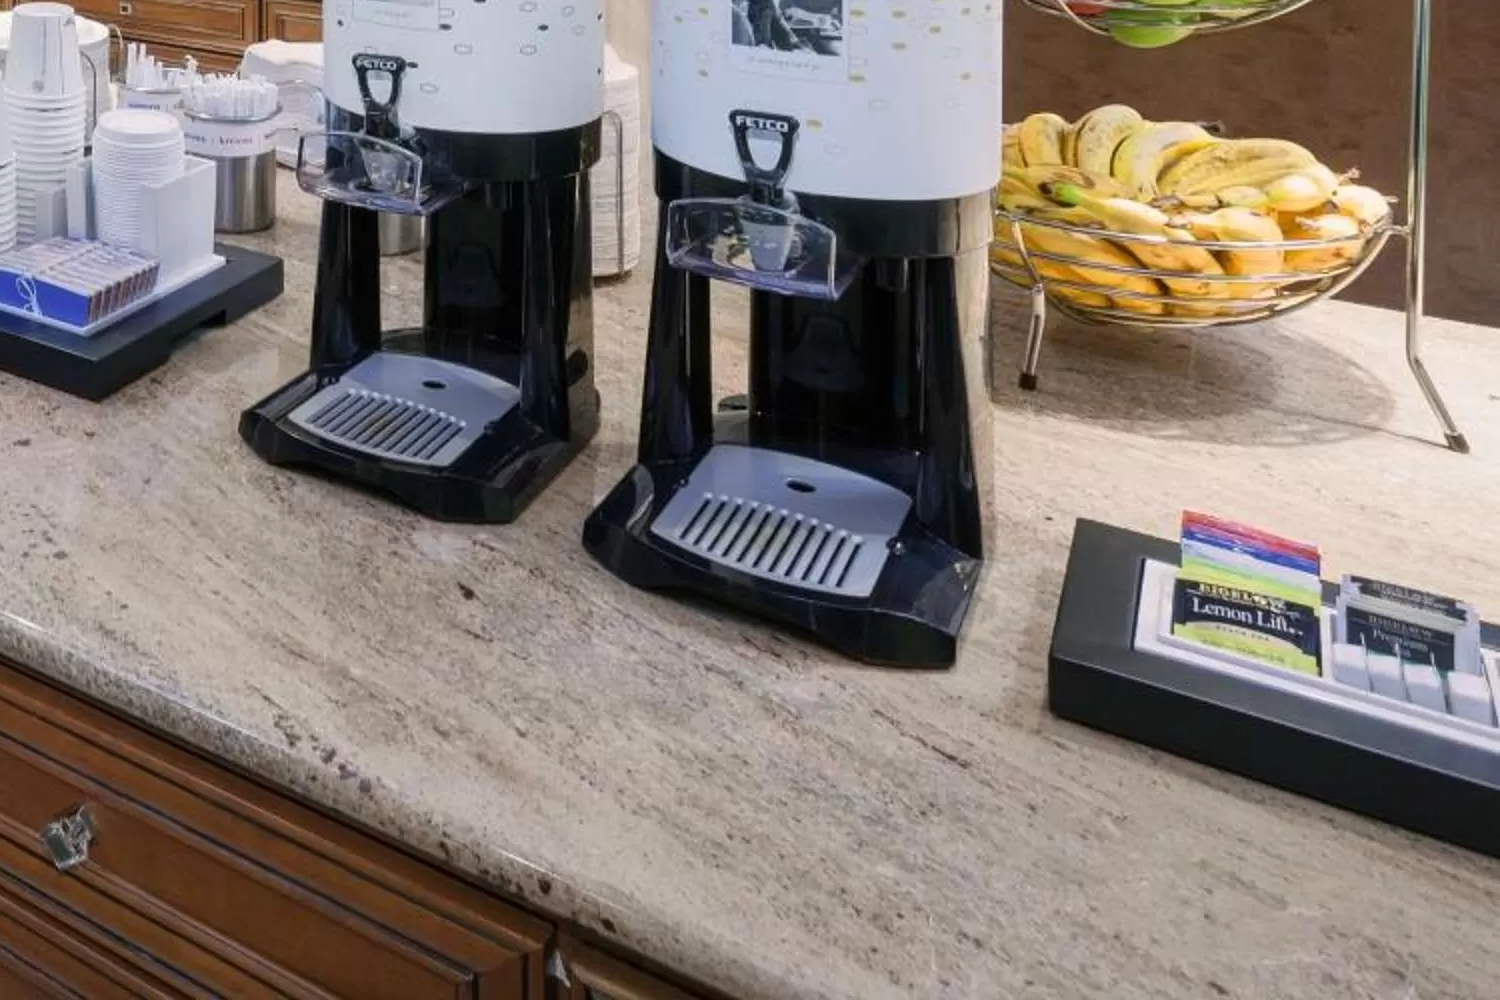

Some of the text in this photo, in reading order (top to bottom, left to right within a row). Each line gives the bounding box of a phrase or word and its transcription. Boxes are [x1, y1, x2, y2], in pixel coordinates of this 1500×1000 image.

[356, 55, 397, 71] FETCO
[735, 115, 789, 133] FETCO
[1191, 596, 1288, 634] Lemon Lift
